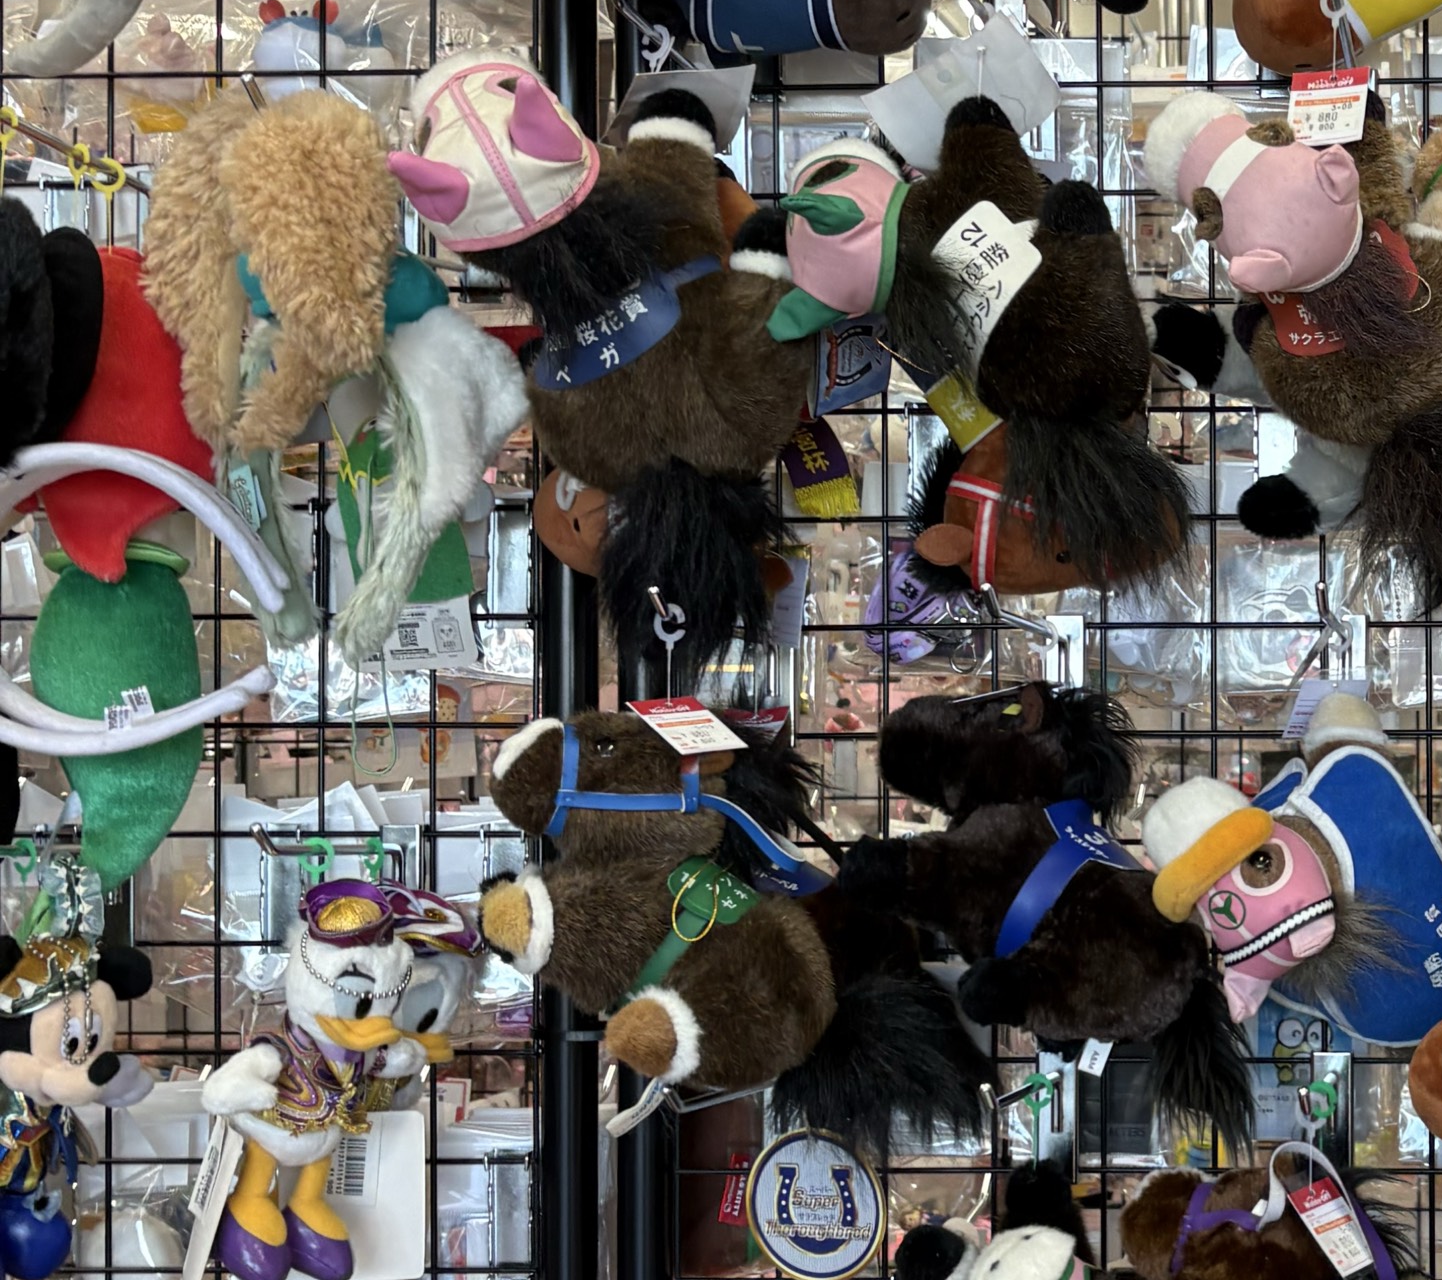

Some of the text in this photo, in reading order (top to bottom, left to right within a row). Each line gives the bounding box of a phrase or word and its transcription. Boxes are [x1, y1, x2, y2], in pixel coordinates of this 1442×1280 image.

[961, 221, 988, 248] 12
[792, 1188, 841, 1210] Super
[764, 1220, 874, 1242] Thoroughbred
